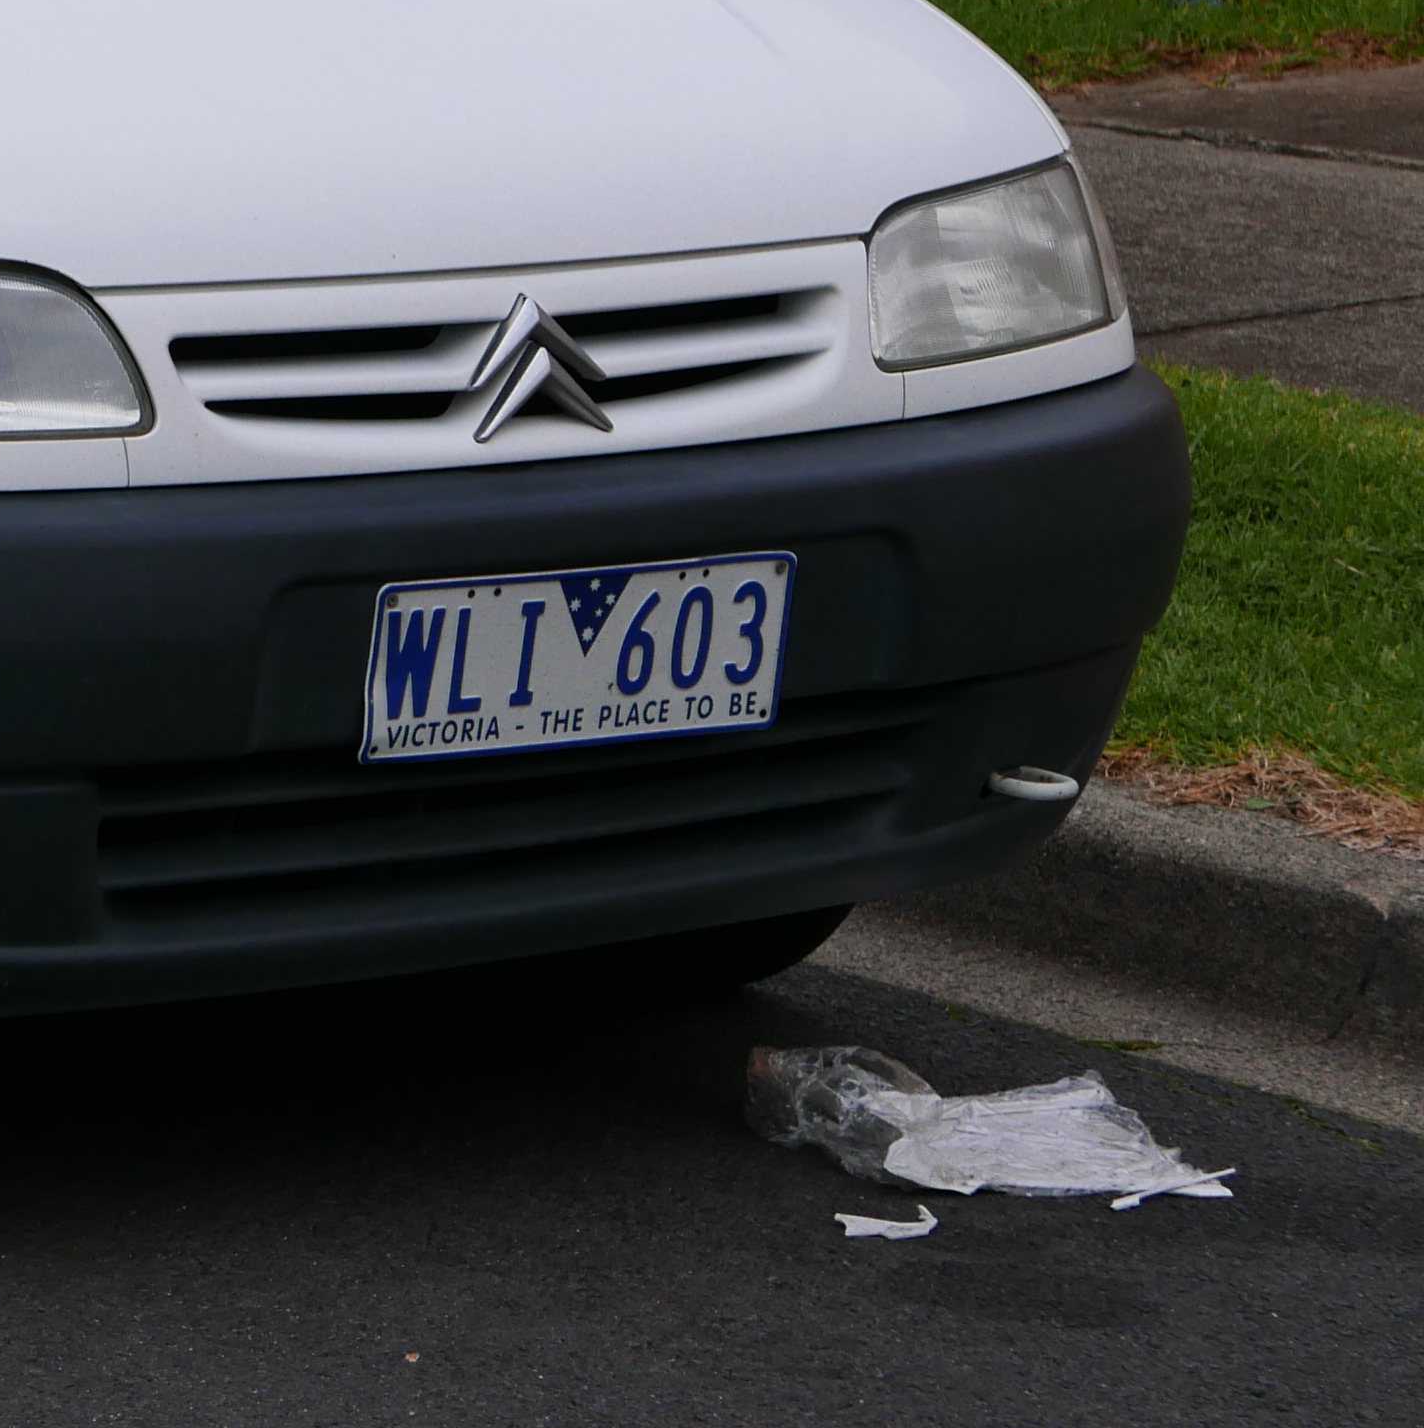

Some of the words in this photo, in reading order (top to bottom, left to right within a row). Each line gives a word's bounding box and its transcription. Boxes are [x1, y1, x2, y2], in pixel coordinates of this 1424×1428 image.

[384, 600, 545, 720] WLI
[615, 579, 768, 696] 603
[386, 715, 500, 749] VICTORIA
[540, 708, 584, 735] THE
[598, 698, 670, 730] PLACE
[684, 693, 714, 720] TO
